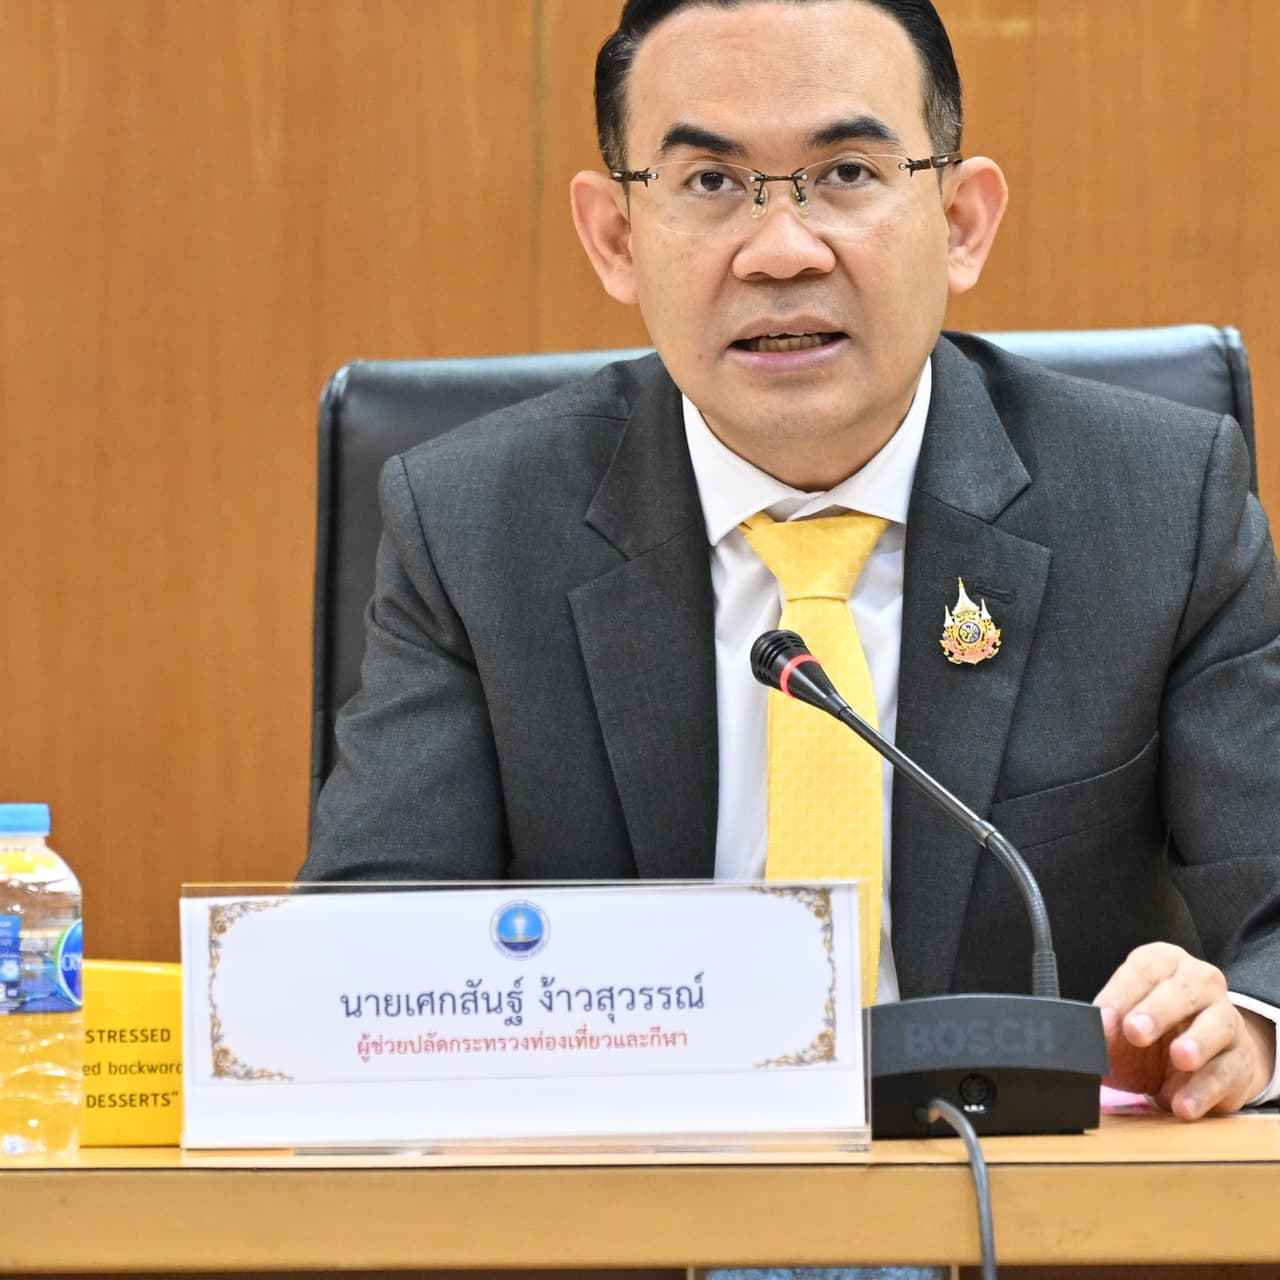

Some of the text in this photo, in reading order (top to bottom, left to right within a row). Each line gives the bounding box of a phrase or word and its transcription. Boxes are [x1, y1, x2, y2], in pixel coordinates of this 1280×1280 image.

[85, 1028, 171, 1044] STRESSED
[902, 1017, 1055, 1057] BOSCH
[82, 1061, 101, 1076] ed
